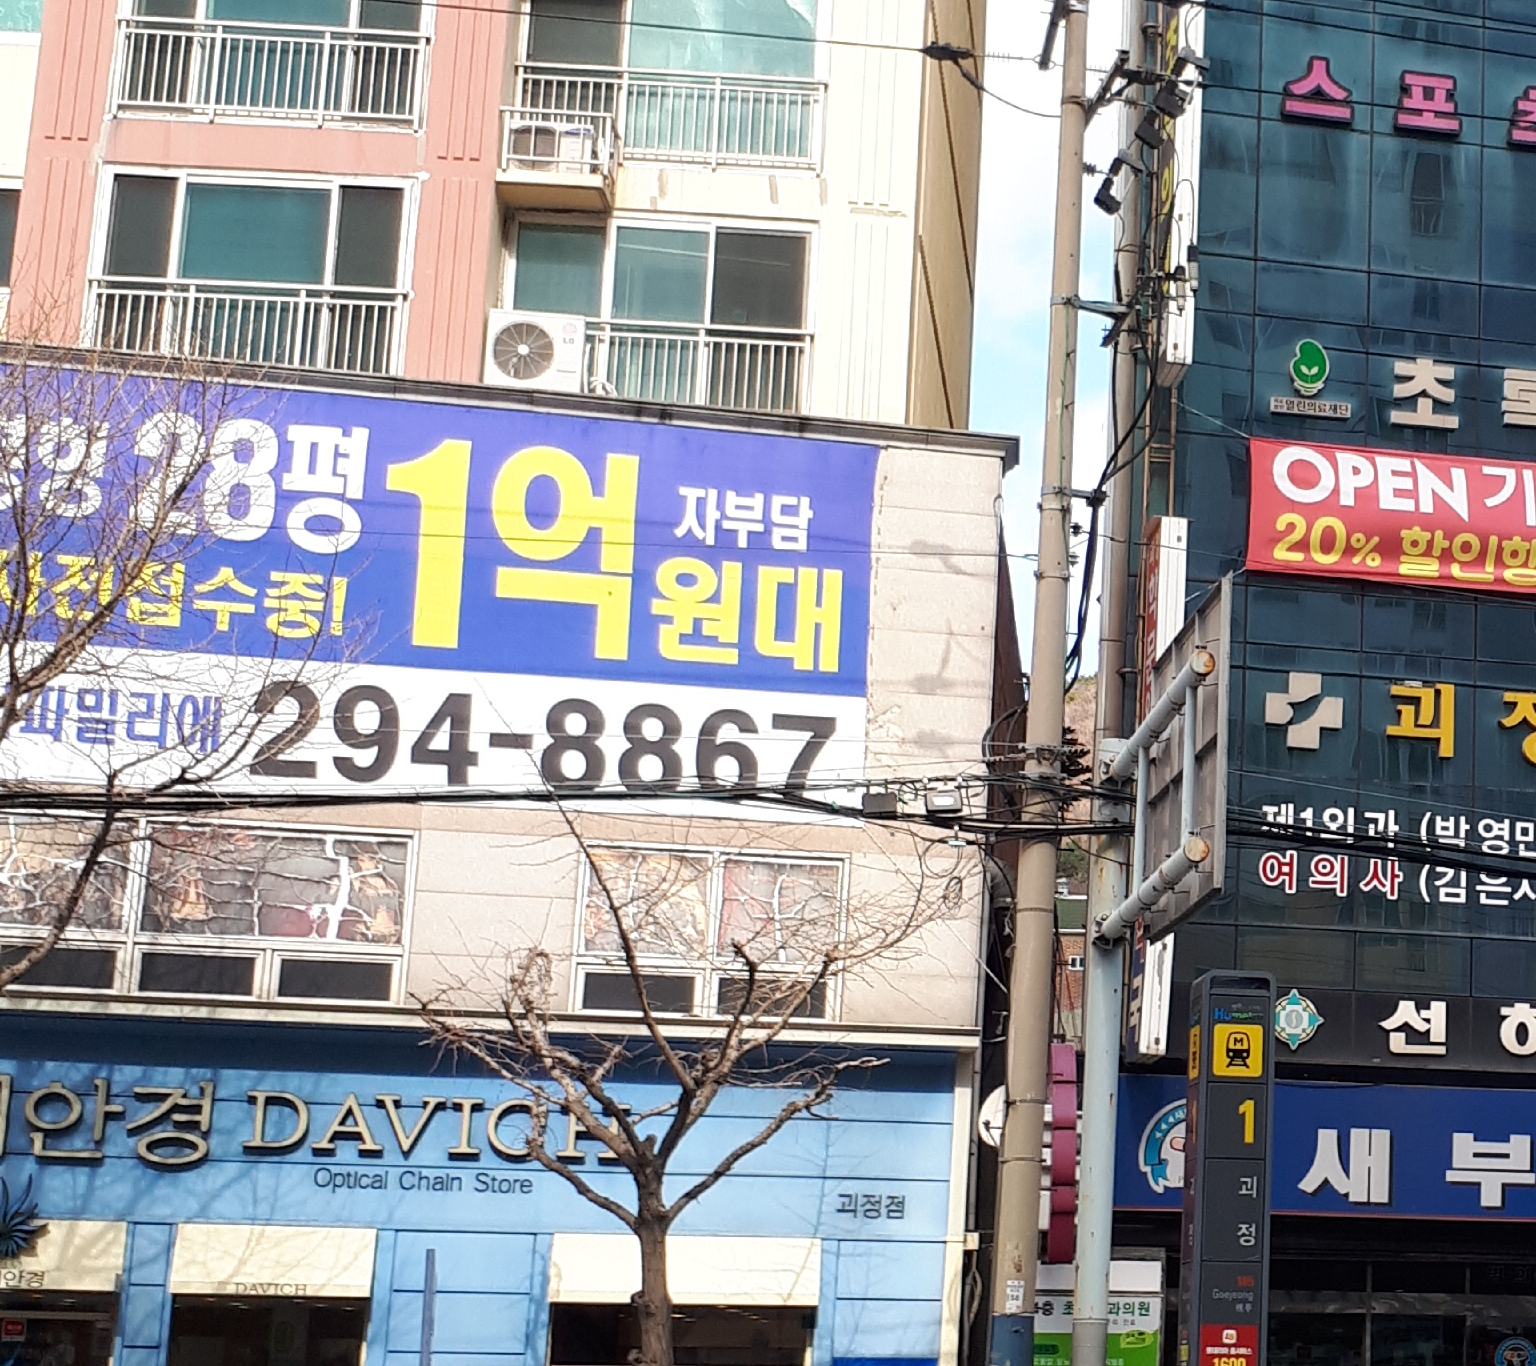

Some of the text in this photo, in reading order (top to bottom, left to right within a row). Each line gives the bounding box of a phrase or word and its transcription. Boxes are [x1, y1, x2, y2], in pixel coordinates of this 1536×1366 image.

[676, 483, 815, 553] 자부담
[1272, 445, 1470, 522] OPEN
[387, 438, 642, 662] 1억
[1272, 512, 1382, 569] 20%
[650, 555, 844, 674] 원대
[252, 679, 838, 793] 294-8867
[1259, 850, 1404, 901] 여의사
[313, 1166, 534, 1195] Optical Chain Store
[836, 1190, 907, 1221] 괴정점
